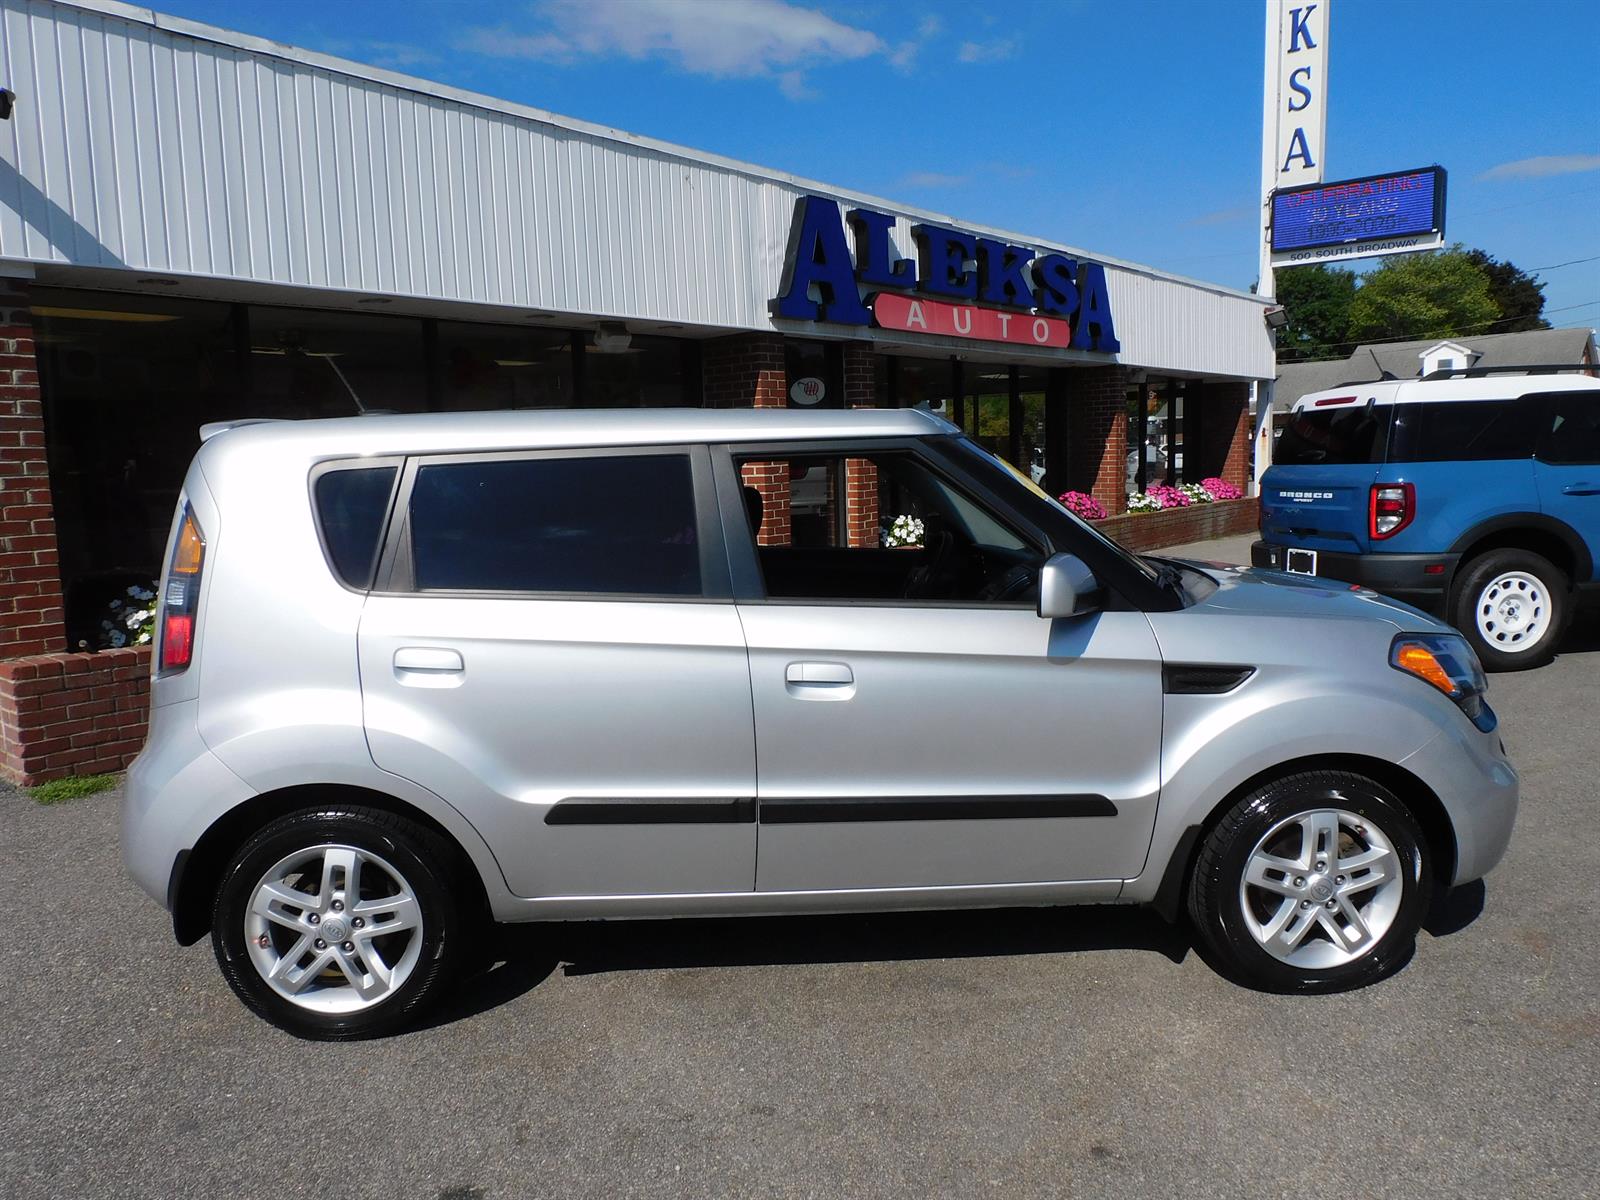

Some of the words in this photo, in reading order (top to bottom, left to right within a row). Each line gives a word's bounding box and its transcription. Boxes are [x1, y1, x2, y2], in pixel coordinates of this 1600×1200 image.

[1290, 251, 1312, 261] 500
[1315, 247, 1355, 258] SOUTH
[1357, 239, 1419, 253] BROADWAY
[769, 195, 1121, 353] ALEKSA
[906, 301, 1050, 344] AUTO
[1280, 491, 1333, 499] BRONCO
